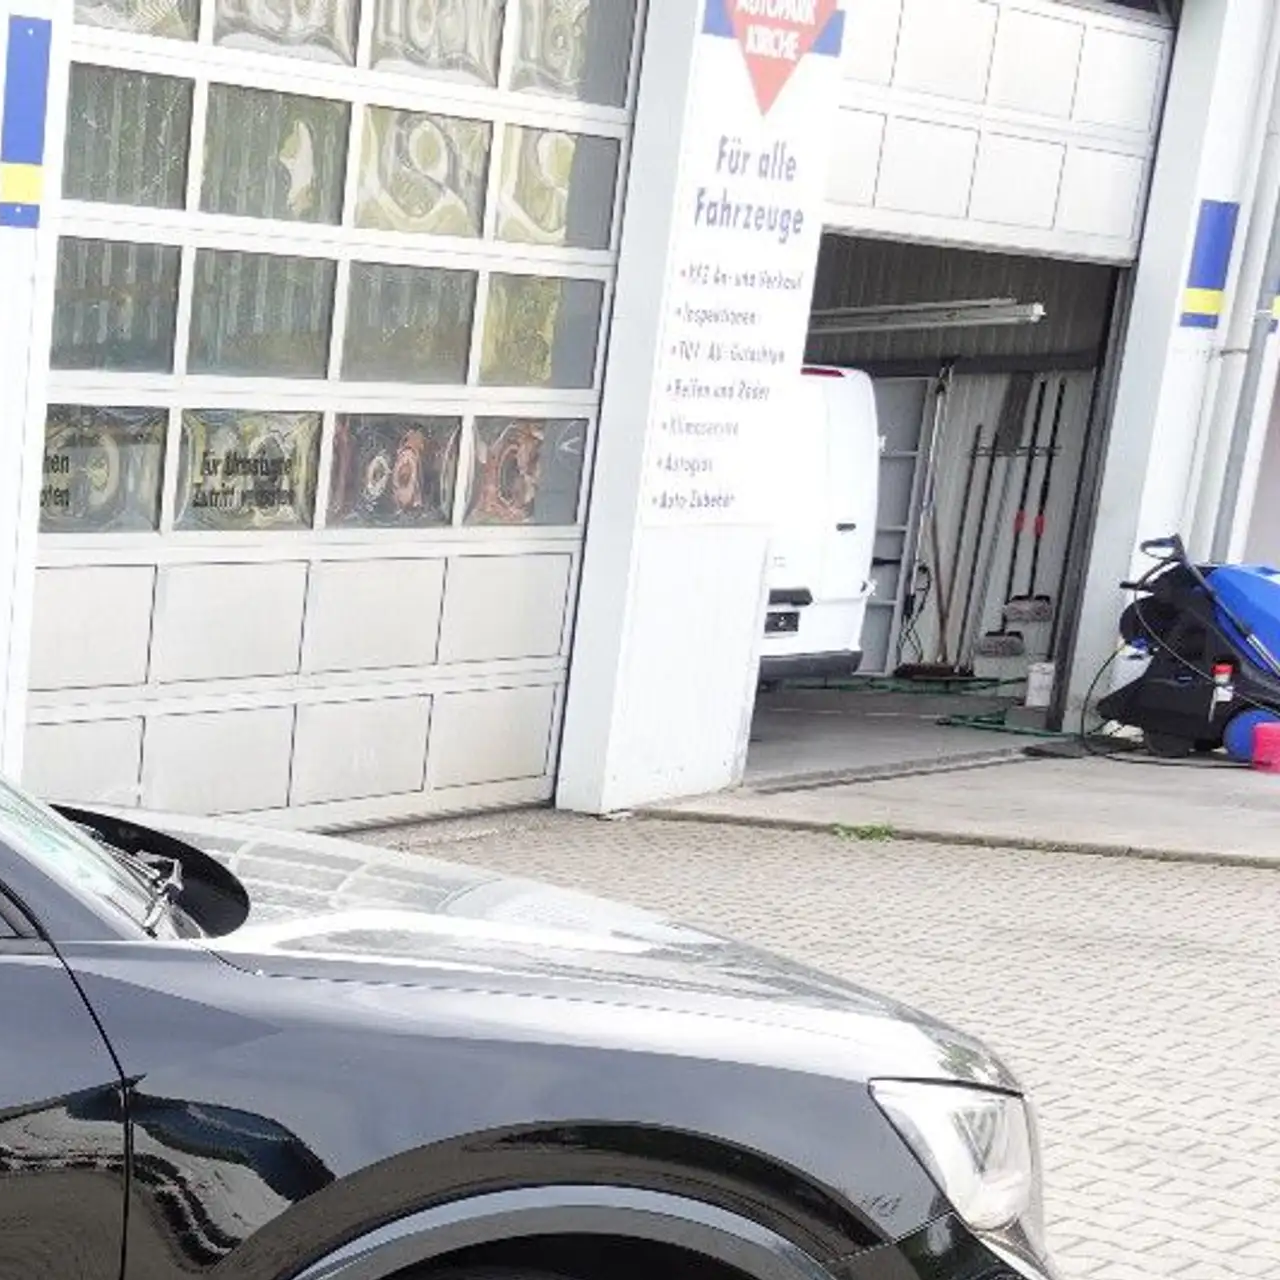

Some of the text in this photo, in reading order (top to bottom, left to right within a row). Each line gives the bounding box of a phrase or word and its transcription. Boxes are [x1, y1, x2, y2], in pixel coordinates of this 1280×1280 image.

[745, 24, 801, 61] KIRCHE
[716, 135, 797, 182] Für alle
[694, 187, 804, 244] Fahrzeuge
